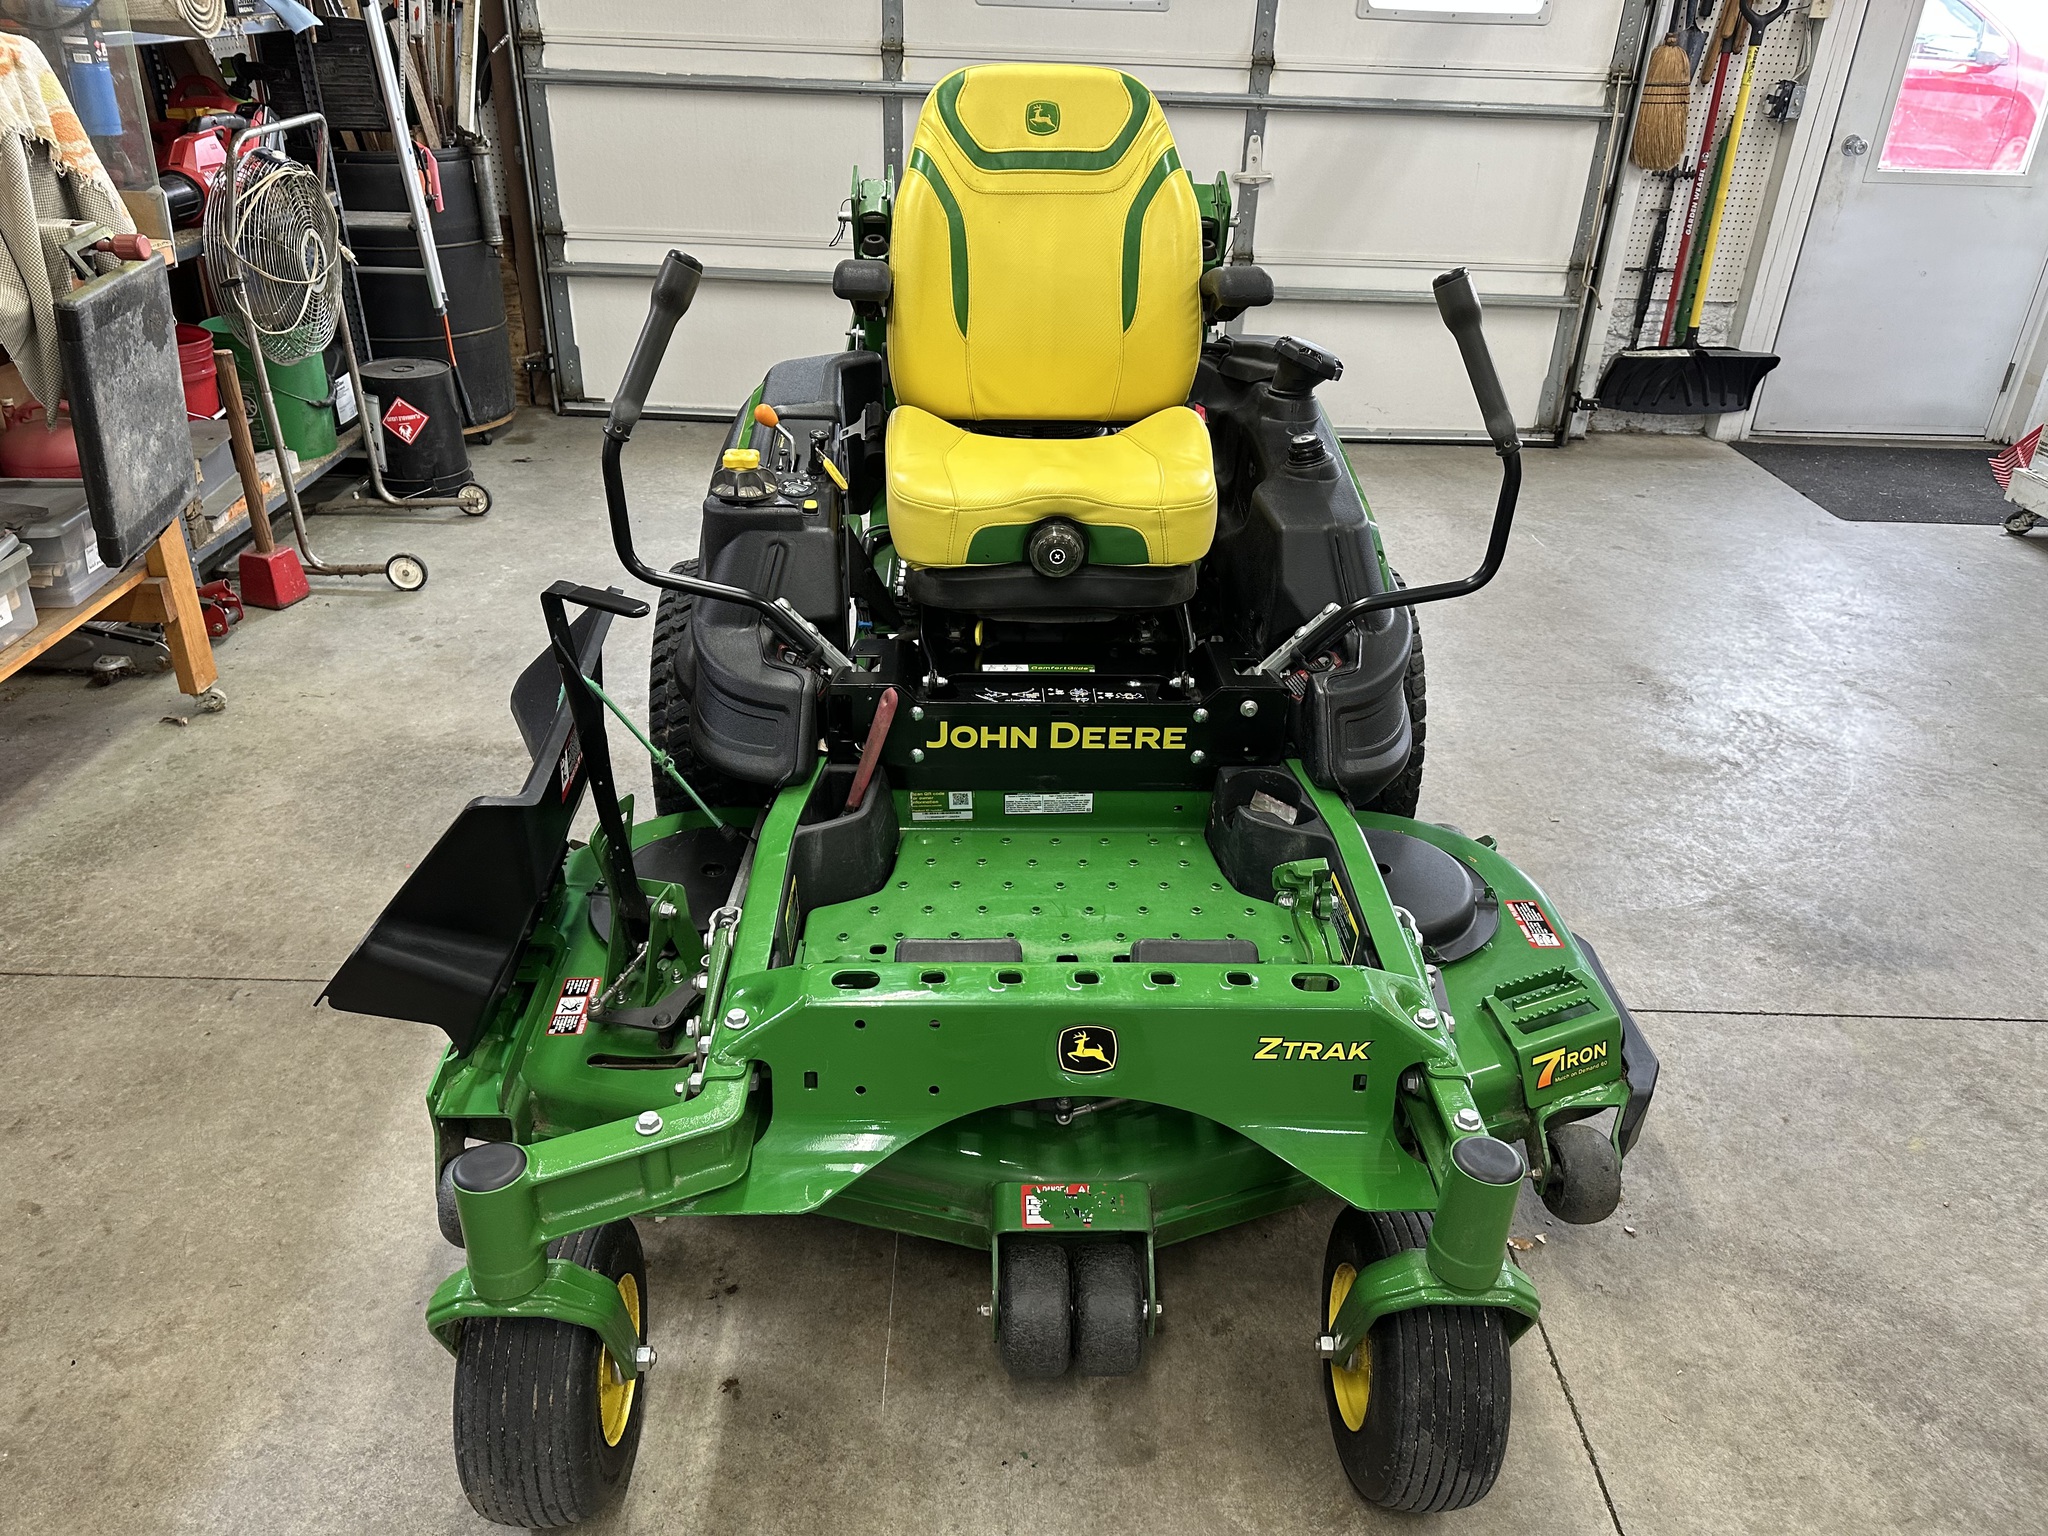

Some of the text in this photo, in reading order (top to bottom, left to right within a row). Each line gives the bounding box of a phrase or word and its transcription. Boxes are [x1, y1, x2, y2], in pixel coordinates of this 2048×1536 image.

[1685, 168, 1706, 236] GARDEN WEASEL
[926, 721, 1188, 749] JOHN DEERE
[1253, 1037, 1374, 1061] ZTRAK
[1554, 1073, 1570, 1083] Mulch
[1578, 1062, 1600, 1075] Demand
